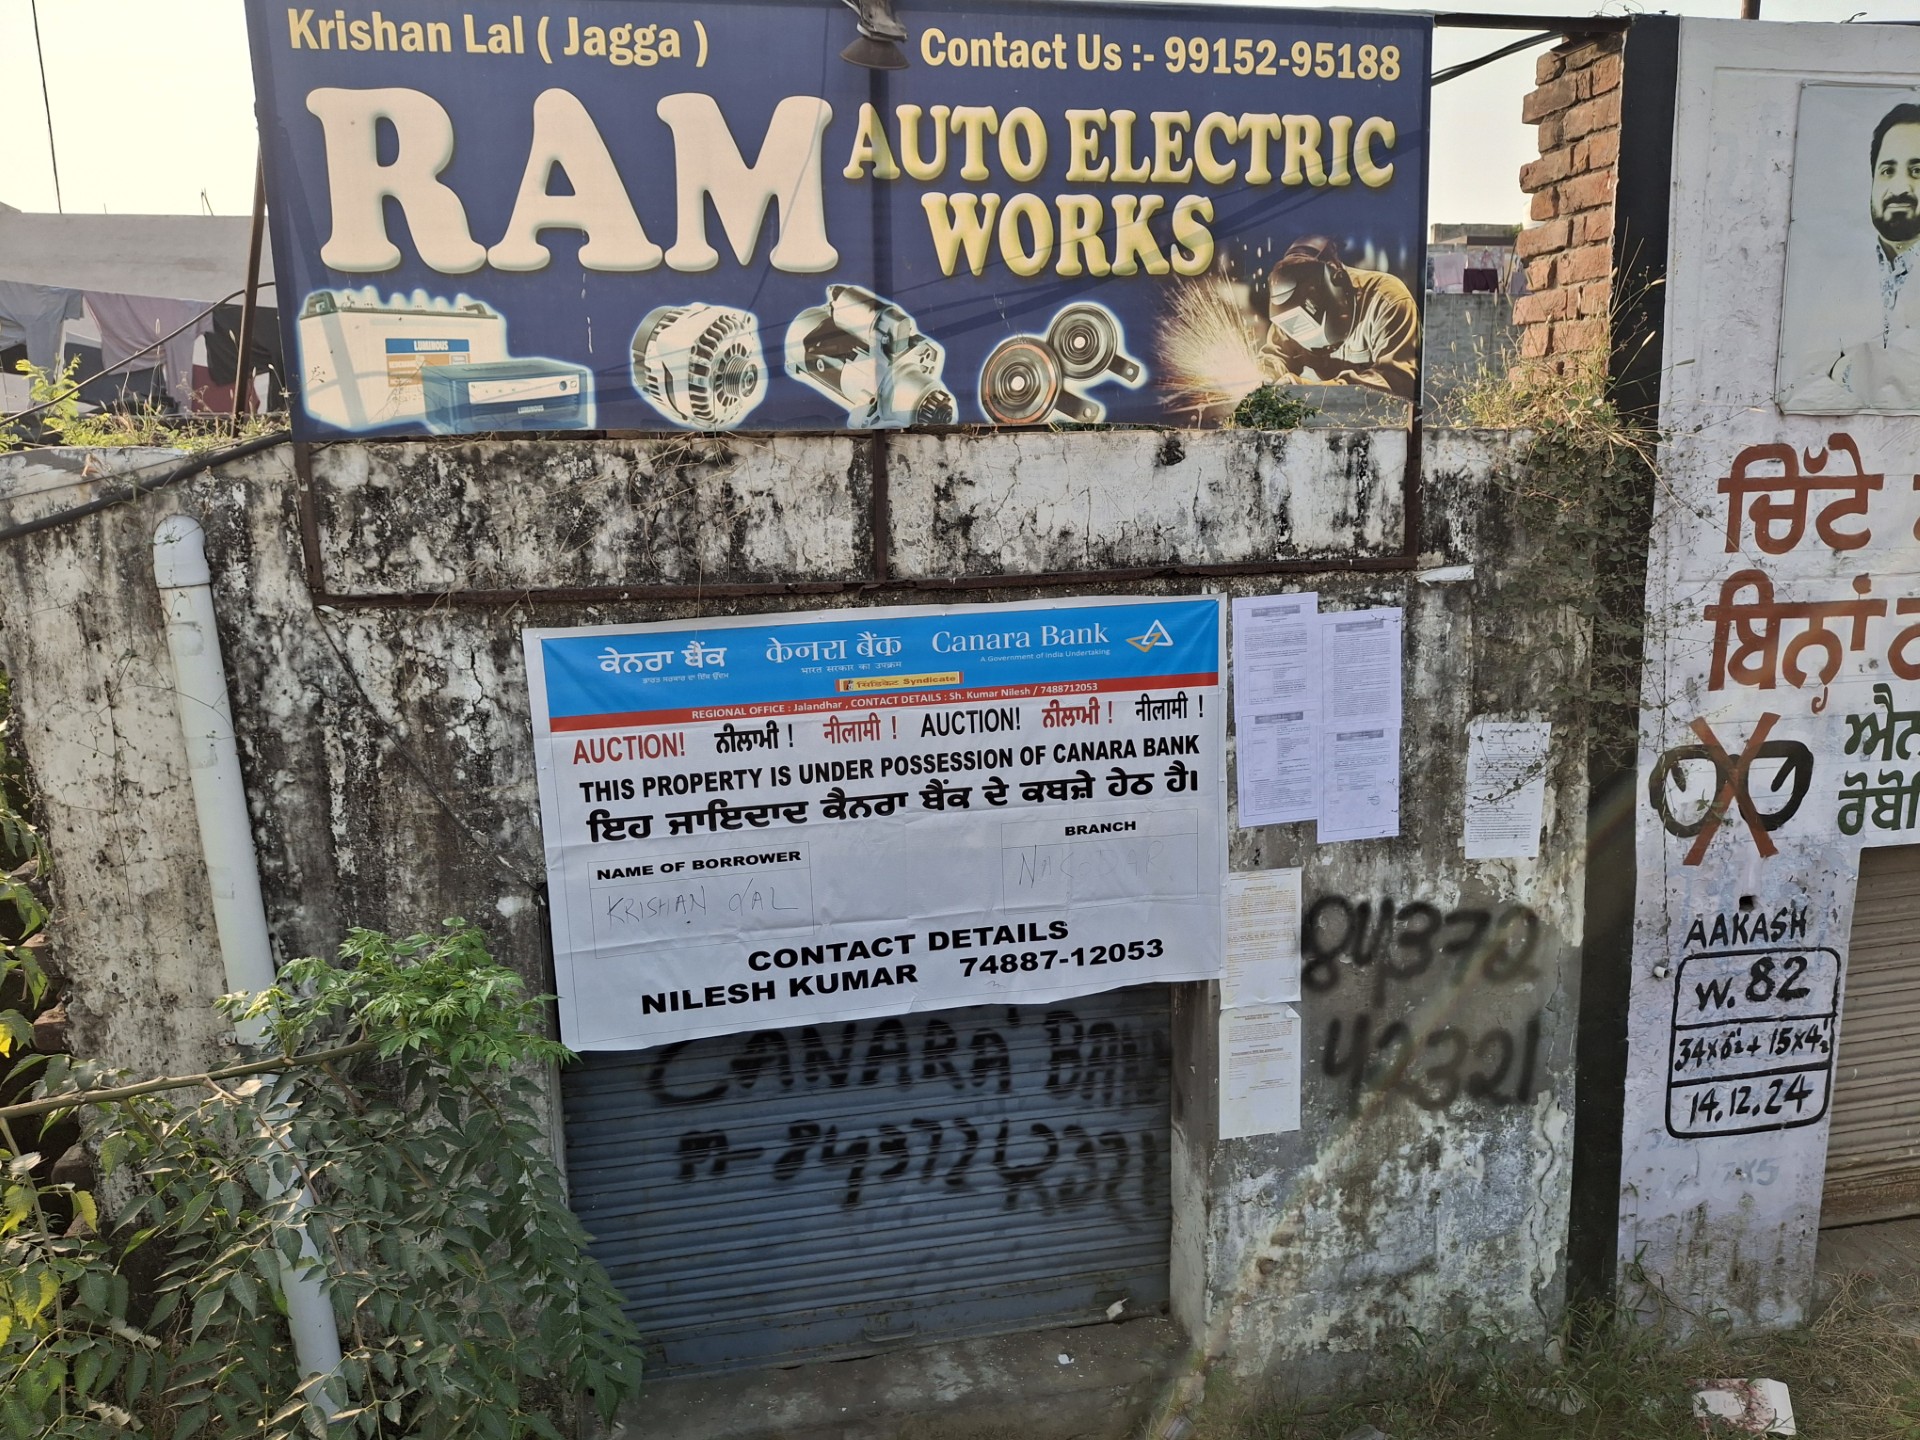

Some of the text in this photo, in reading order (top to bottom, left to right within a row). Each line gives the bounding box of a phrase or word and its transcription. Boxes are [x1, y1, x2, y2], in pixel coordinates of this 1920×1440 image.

[287, 7, 452, 53] Krishan
[464, 13, 525, 55] Lal
[562, 16, 682, 67] Jagga
[920, 27, 1067, 71] Contact
[1077, 33, 1122, 72] Us
[1164, 36, 1401, 82] 99152-95188
[843, 102, 1396, 188] AUTO ELECTRIC
[305, 86, 840, 274] RAM
[920, 191, 1215, 277] WORKS
[1717, 432, 1885, 555] ਚਿੱਟੇ
[597, 640, 728, 674] ਕੇਨਰਾ ਬੈਂਕ
[765, 631, 902, 663] केनरा बैंक
[931, 622, 1111, 654] Canara Bank
[987, 653, 1034, 662] Government
[1045, 651, 1064, 659] India
[1065, 648, 1111, 658] Undertaking
[801, 666, 823, 675] भारत
[827, 664, 854, 673] सरकार
[875, 661, 902, 670] उपक्रम
[902, 675, 956, 686] Syndicate
[691, 707, 747, 720] REGIONAL
[749, 704, 785, 716] OFFICE
[793, 700, 842, 713] Jalandhar
[850, 696, 899, 708] CONTACT
[901, 693, 942, 705] DETAILS
[949, 691, 965, 701] Sh.
[967, 689, 998, 700] Kumar
[1001, 686, 1031, 697] Nilesh
[1040, 682, 1098, 695] 7488712053
[1042, 696, 1100, 729] ਨੀਲਾਮੀ
[1135, 690, 1188, 723] नीलामी
[714, 719, 779, 754] ਨੀਲਾਮੀ
[823, 711, 881, 744] नीलामी
[920, 706, 1021, 737] AUCTION!
[573, 731, 686, 765] AUCTION!
[579, 734, 1200, 803] THIS PROPERTY IS UNDER POSSESSION OF CANARA BANK
[586, 808, 654, 843] ਇਹ
[665, 798, 809, 836] ਜਾਇਦਾਦ
[820, 787, 908, 822] ਕੈਨਰਾ
[919, 778, 973, 811] ਬੈਂਕ
[982, 776, 1010, 806] ਦੇ
[1019, 769, 1096, 803] ਕਬਜ਼ੇ
[1106, 767, 1154, 797] ਹੇਠ
[1065, 820, 1137, 837] BRANCH
[596, 850, 802, 881] NAME OF BORROWER
[607, 885, 707, 924] KRISHAN
[747, 919, 1070, 973] CONTACT DETAILS
[1683, 906, 1807, 949] AAKASH
[640, 937, 1165, 1015] NILESH KUMAR 74887-12053
[1745, 956, 1811, 1002] 82
[647, 1017, 1012, 1106] CANARA
[1689, 1073, 1814, 1127] 14.12.24
